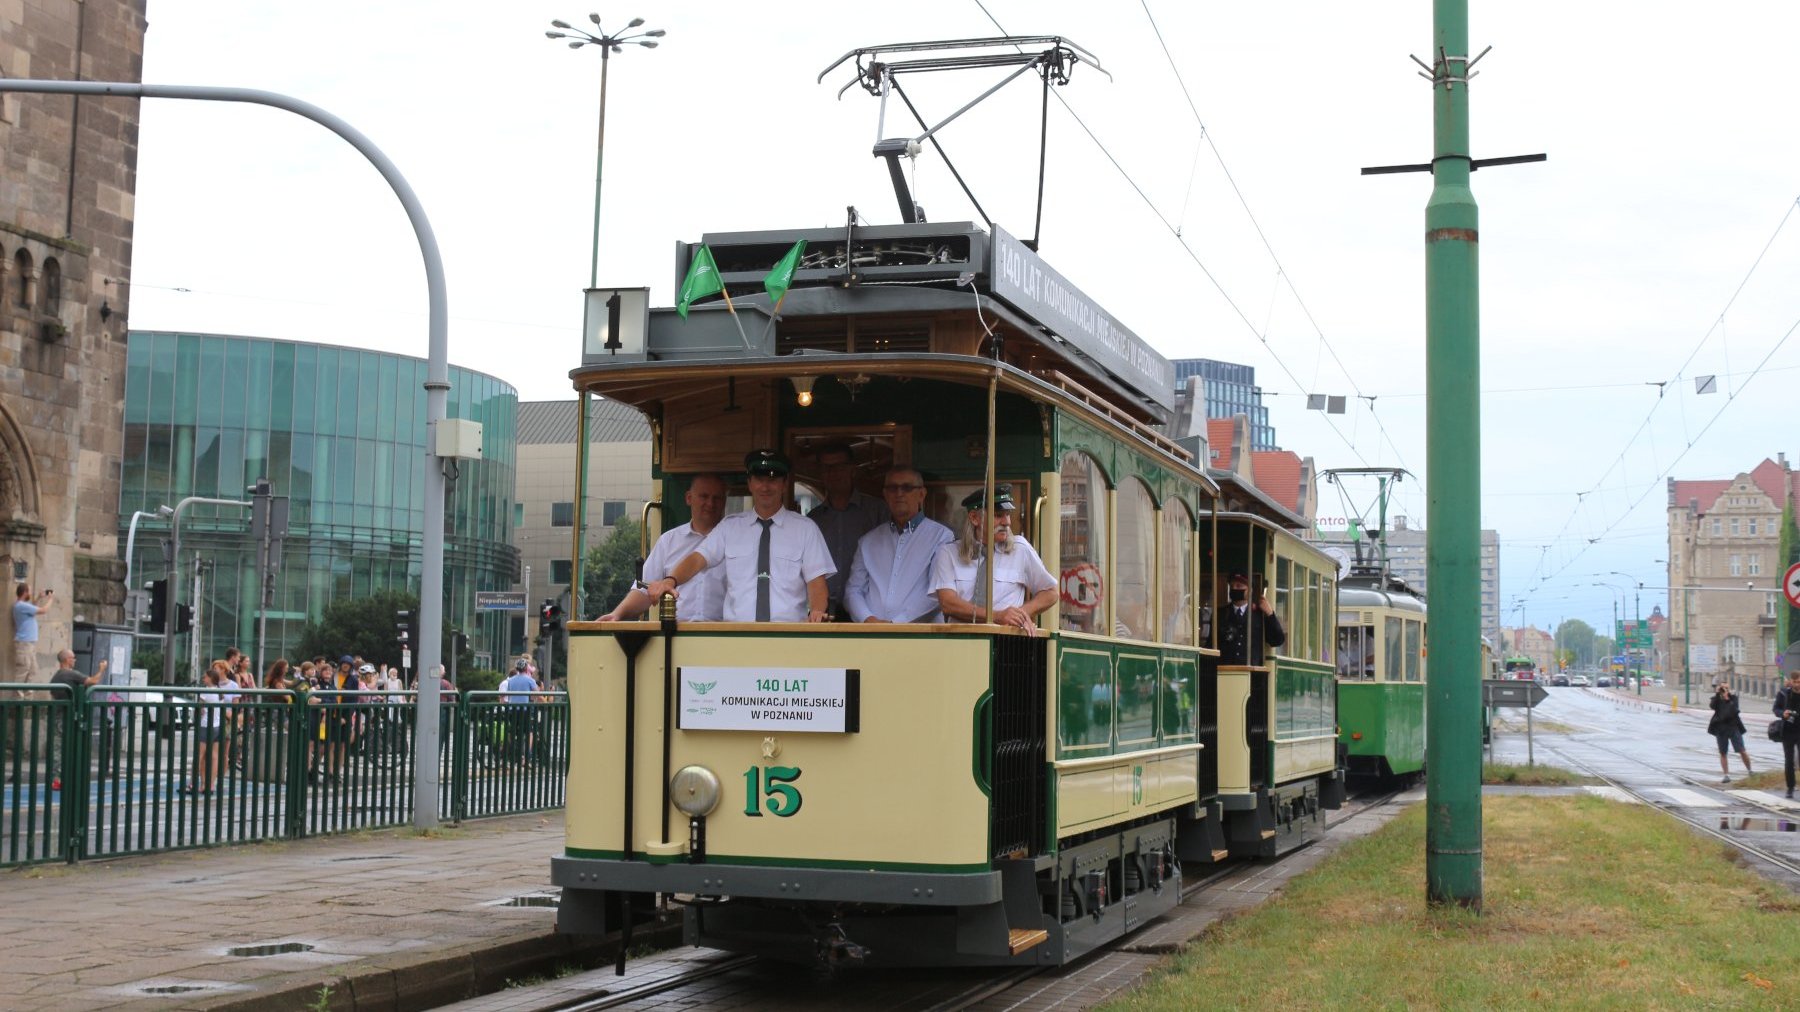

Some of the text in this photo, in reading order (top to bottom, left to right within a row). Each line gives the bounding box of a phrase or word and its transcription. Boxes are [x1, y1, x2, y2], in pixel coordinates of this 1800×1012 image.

[1001, 244, 1020, 288] 140
[1024, 259, 1041, 302] LAT
[1044, 275, 1095, 336] KOMUNIKACJI
[1097, 314, 1129, 362] MIEJSKIEJ
[604, 294, 622, 350] 1
[721, 696, 844, 708] KOMUNIKACJI MIEJSKIEJ
[756, 679, 808, 692] 140 LAT
[751, 710, 813, 720] W POZNANIU
[743, 765, 803, 818] 15
